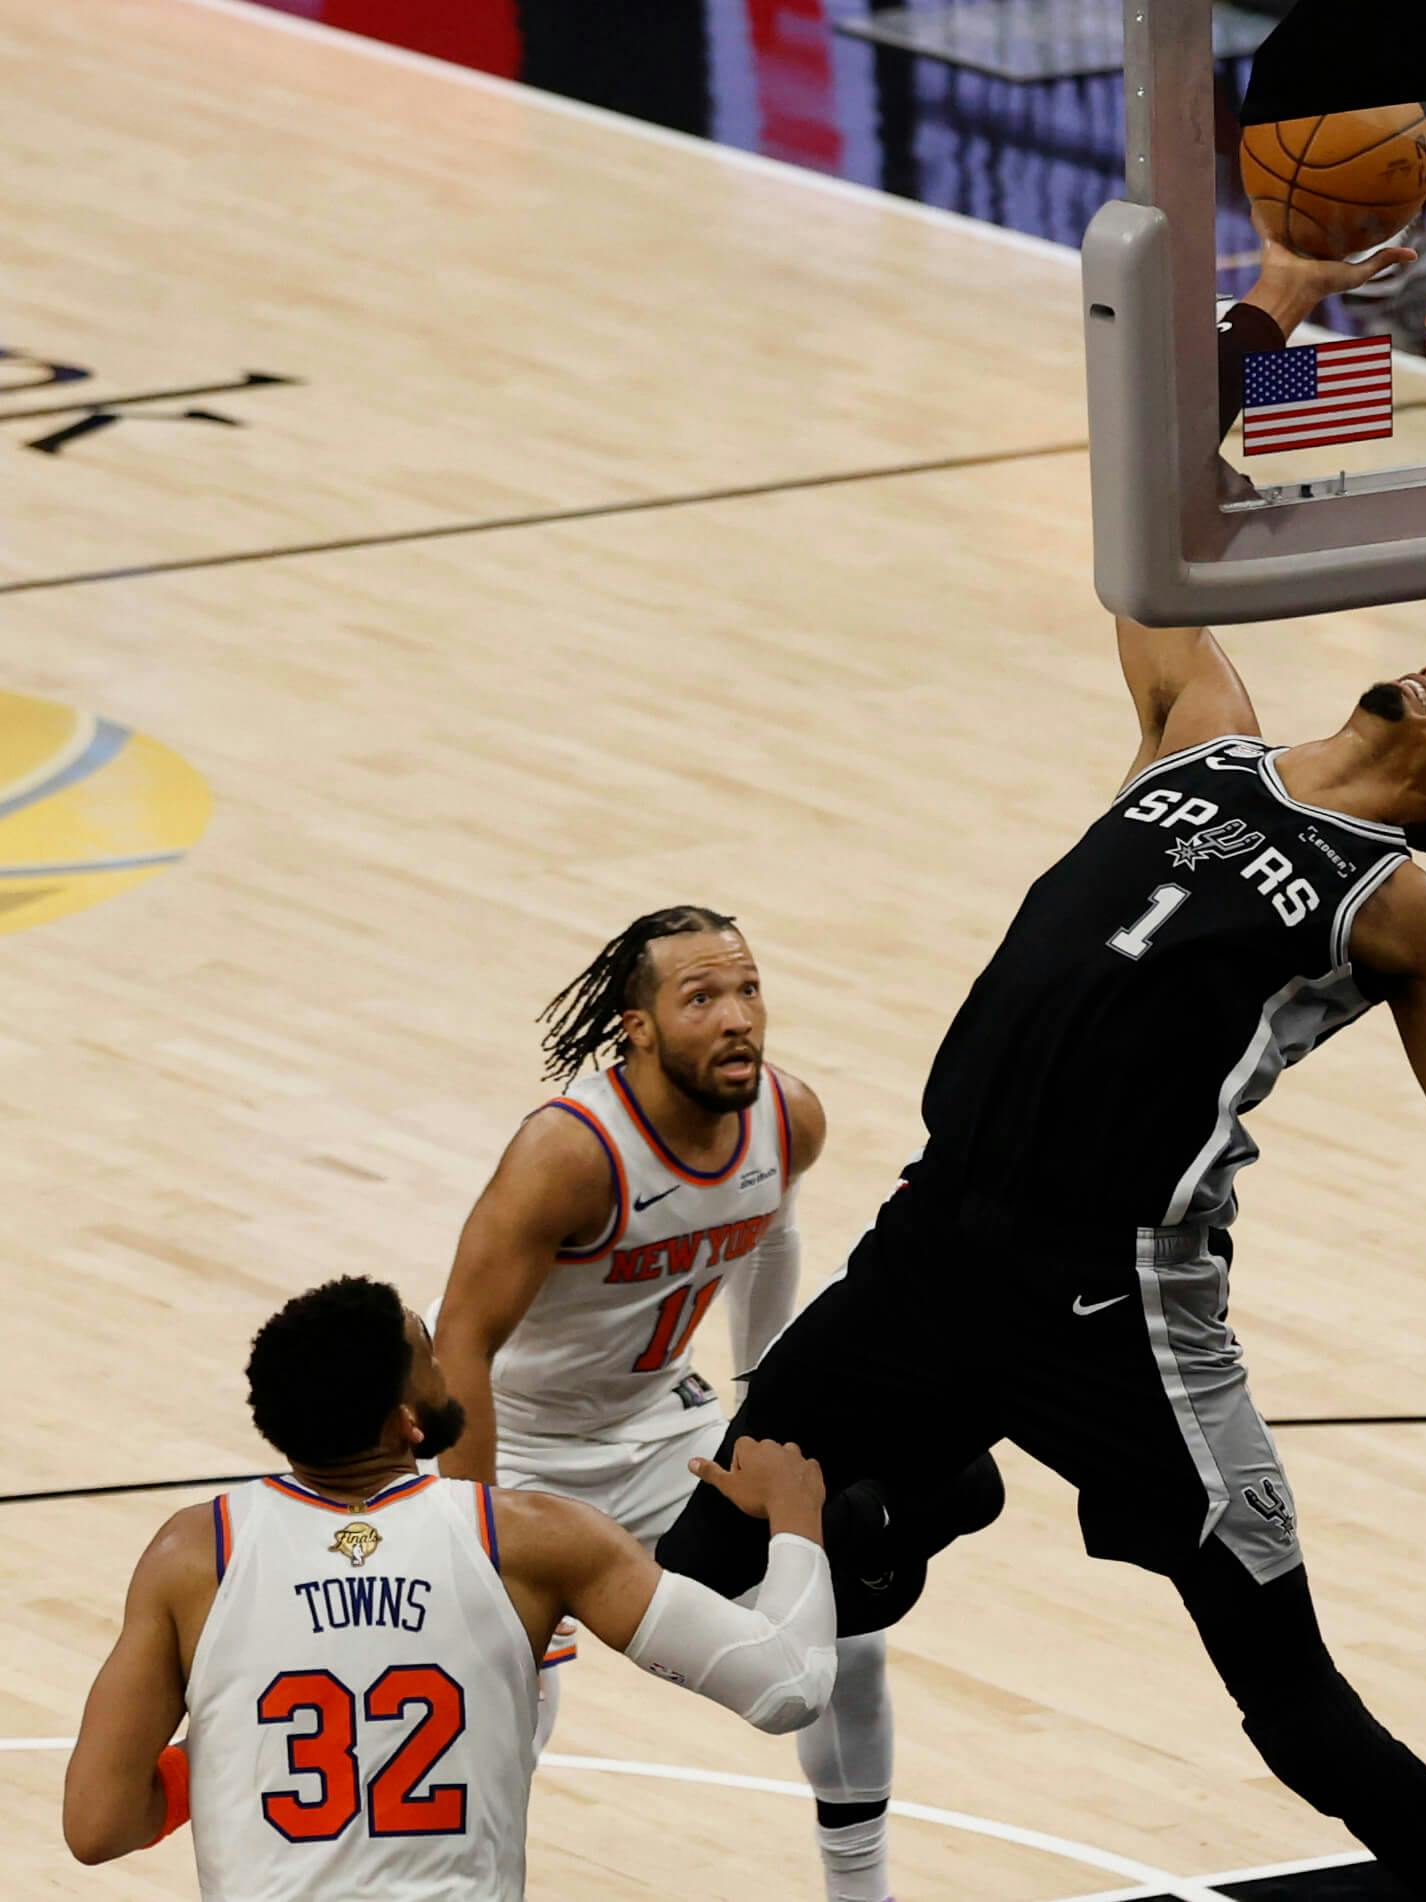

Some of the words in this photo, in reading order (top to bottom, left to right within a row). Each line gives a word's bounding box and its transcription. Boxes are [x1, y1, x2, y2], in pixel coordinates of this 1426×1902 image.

[1124, 789, 1320, 927] SPURS
[1306, 832, 1349, 872] LEDGER
[1105, 882, 1191, 961] 1
[604, 1229, 704, 1284] NEW
[632, 1273, 724, 1373] 11
[294, 1576, 431, 1633] TOWNS
[257, 1663, 467, 1843] 32
